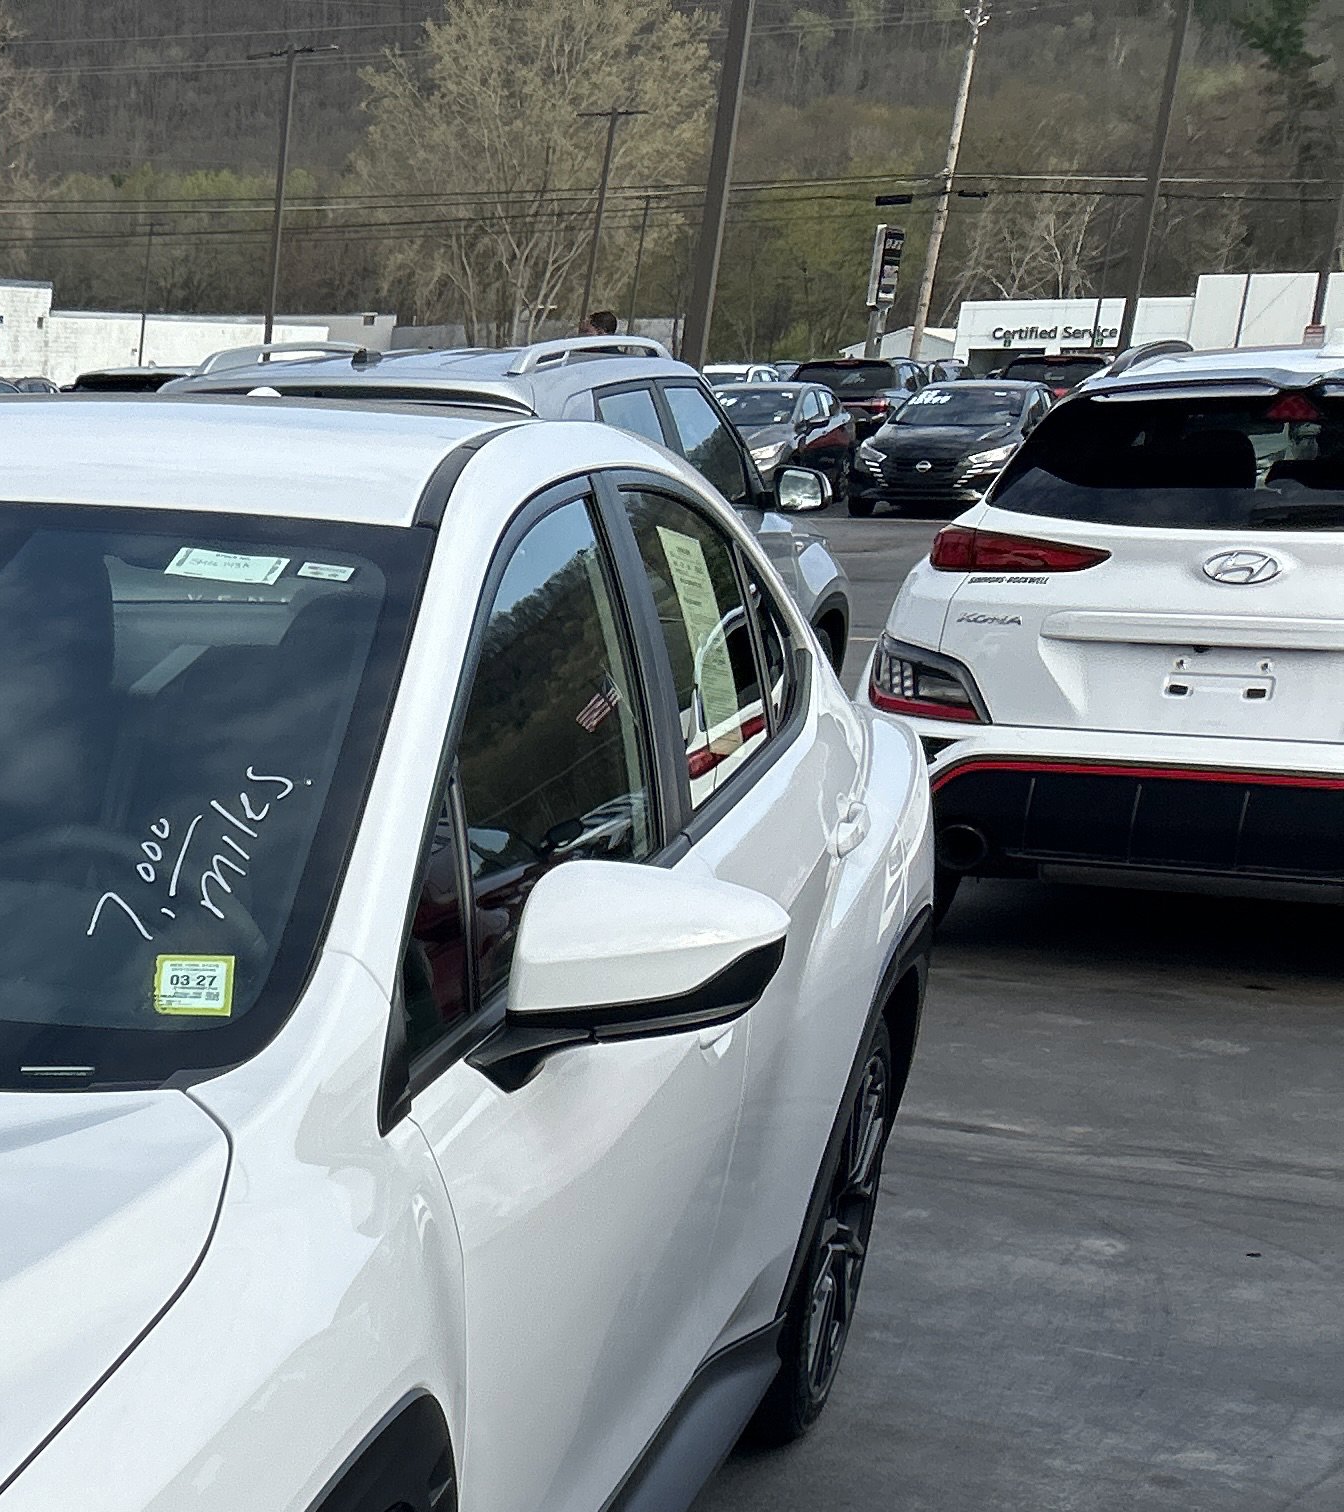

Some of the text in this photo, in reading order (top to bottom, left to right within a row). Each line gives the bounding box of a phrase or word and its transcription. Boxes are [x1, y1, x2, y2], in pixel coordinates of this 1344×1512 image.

[992, 326, 1118, 340] Certified Service
[956, 612, 1023, 626] KONA
[170, 974, 217, 987] 03 27
